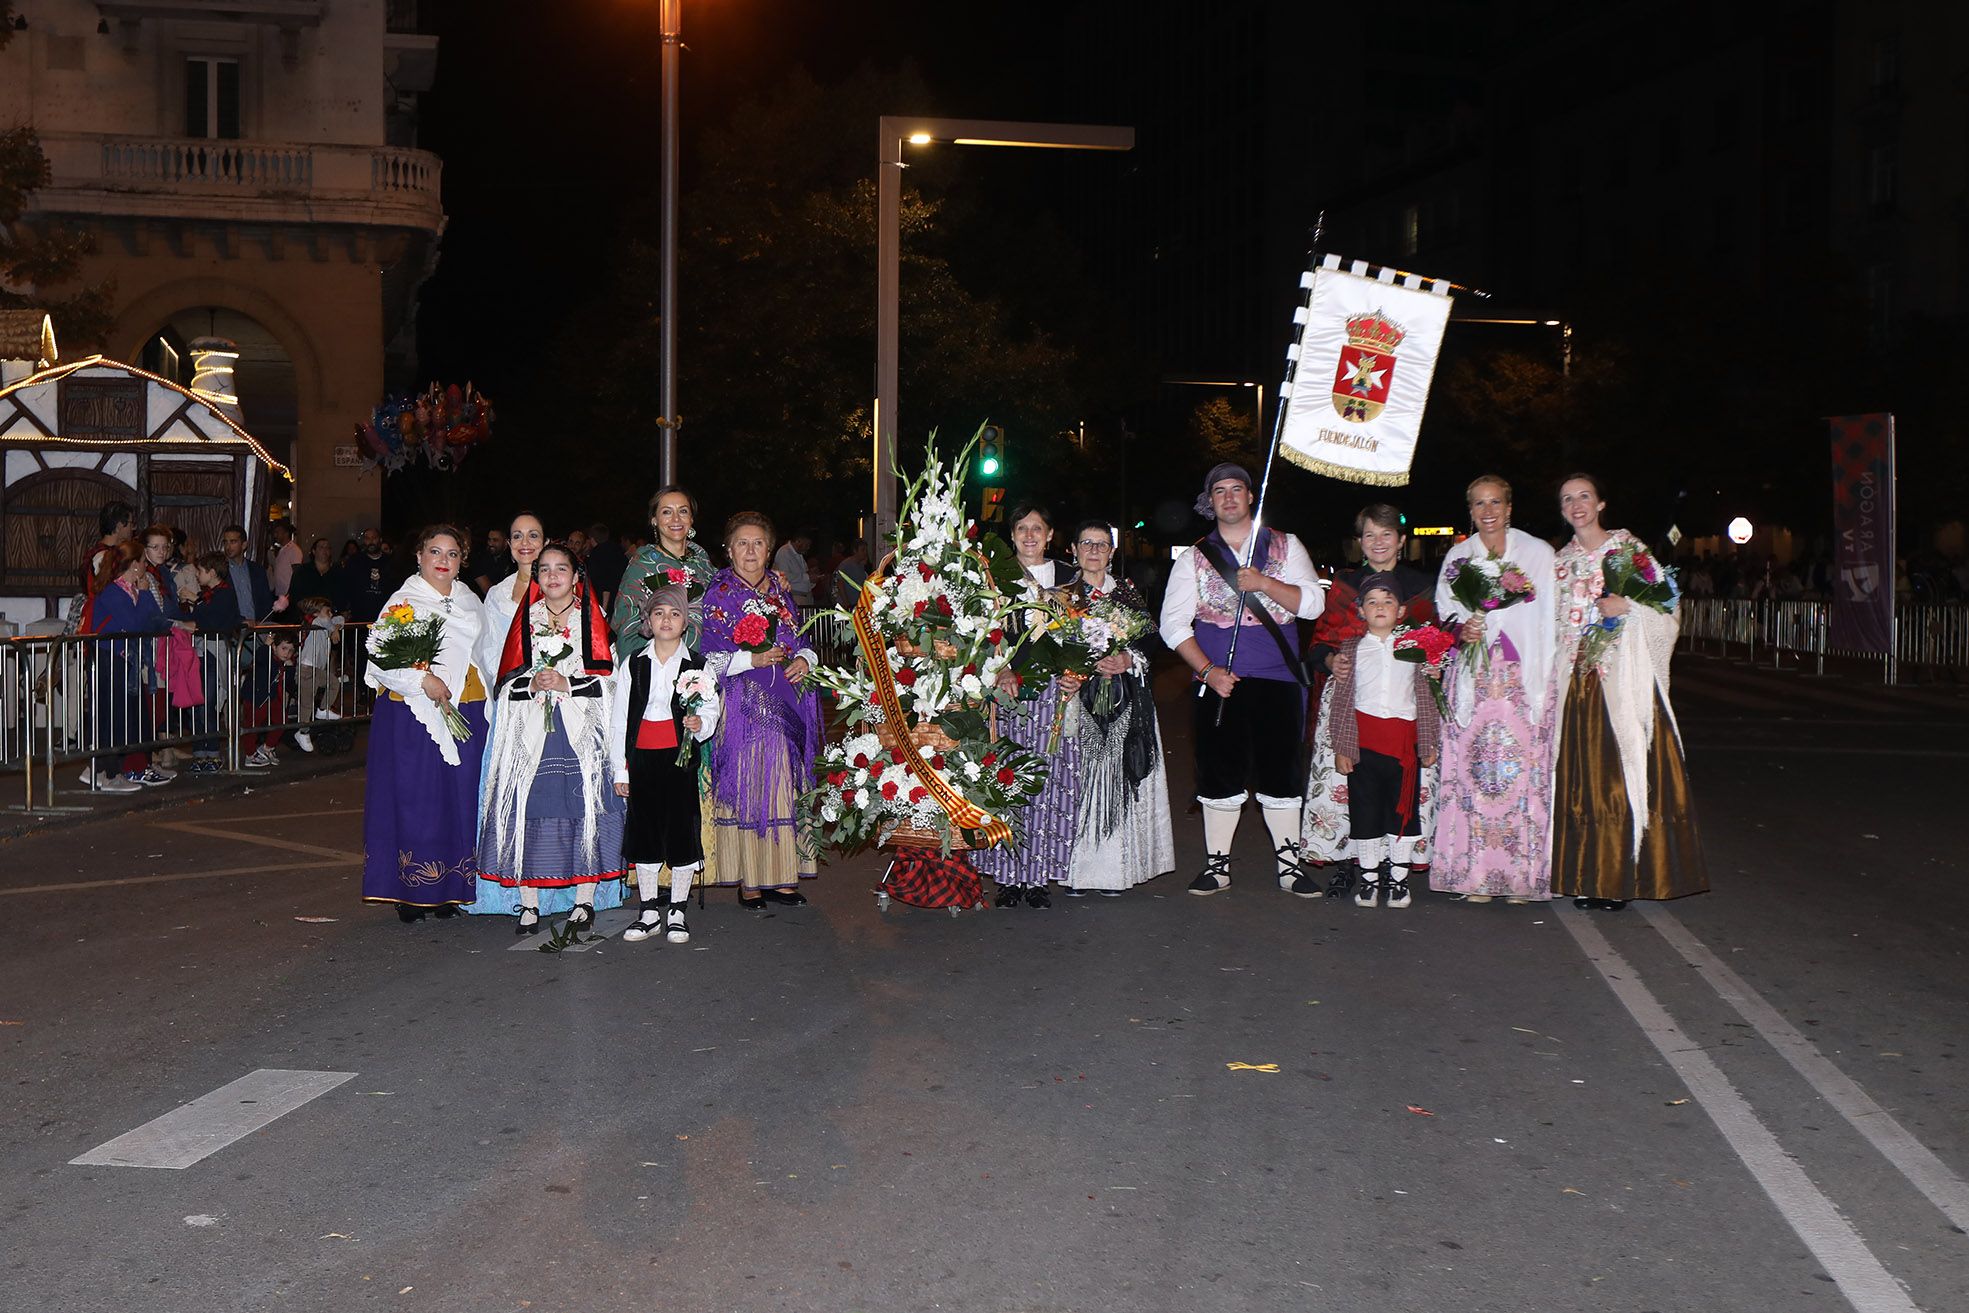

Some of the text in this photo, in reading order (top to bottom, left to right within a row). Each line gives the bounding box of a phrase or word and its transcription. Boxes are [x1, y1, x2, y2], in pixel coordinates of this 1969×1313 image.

[1318, 428, 1380, 453] FUENDEJALÓN
[857, 605, 893, 702] AYUNTAMIENTO
[889, 702, 898, 718] DE
